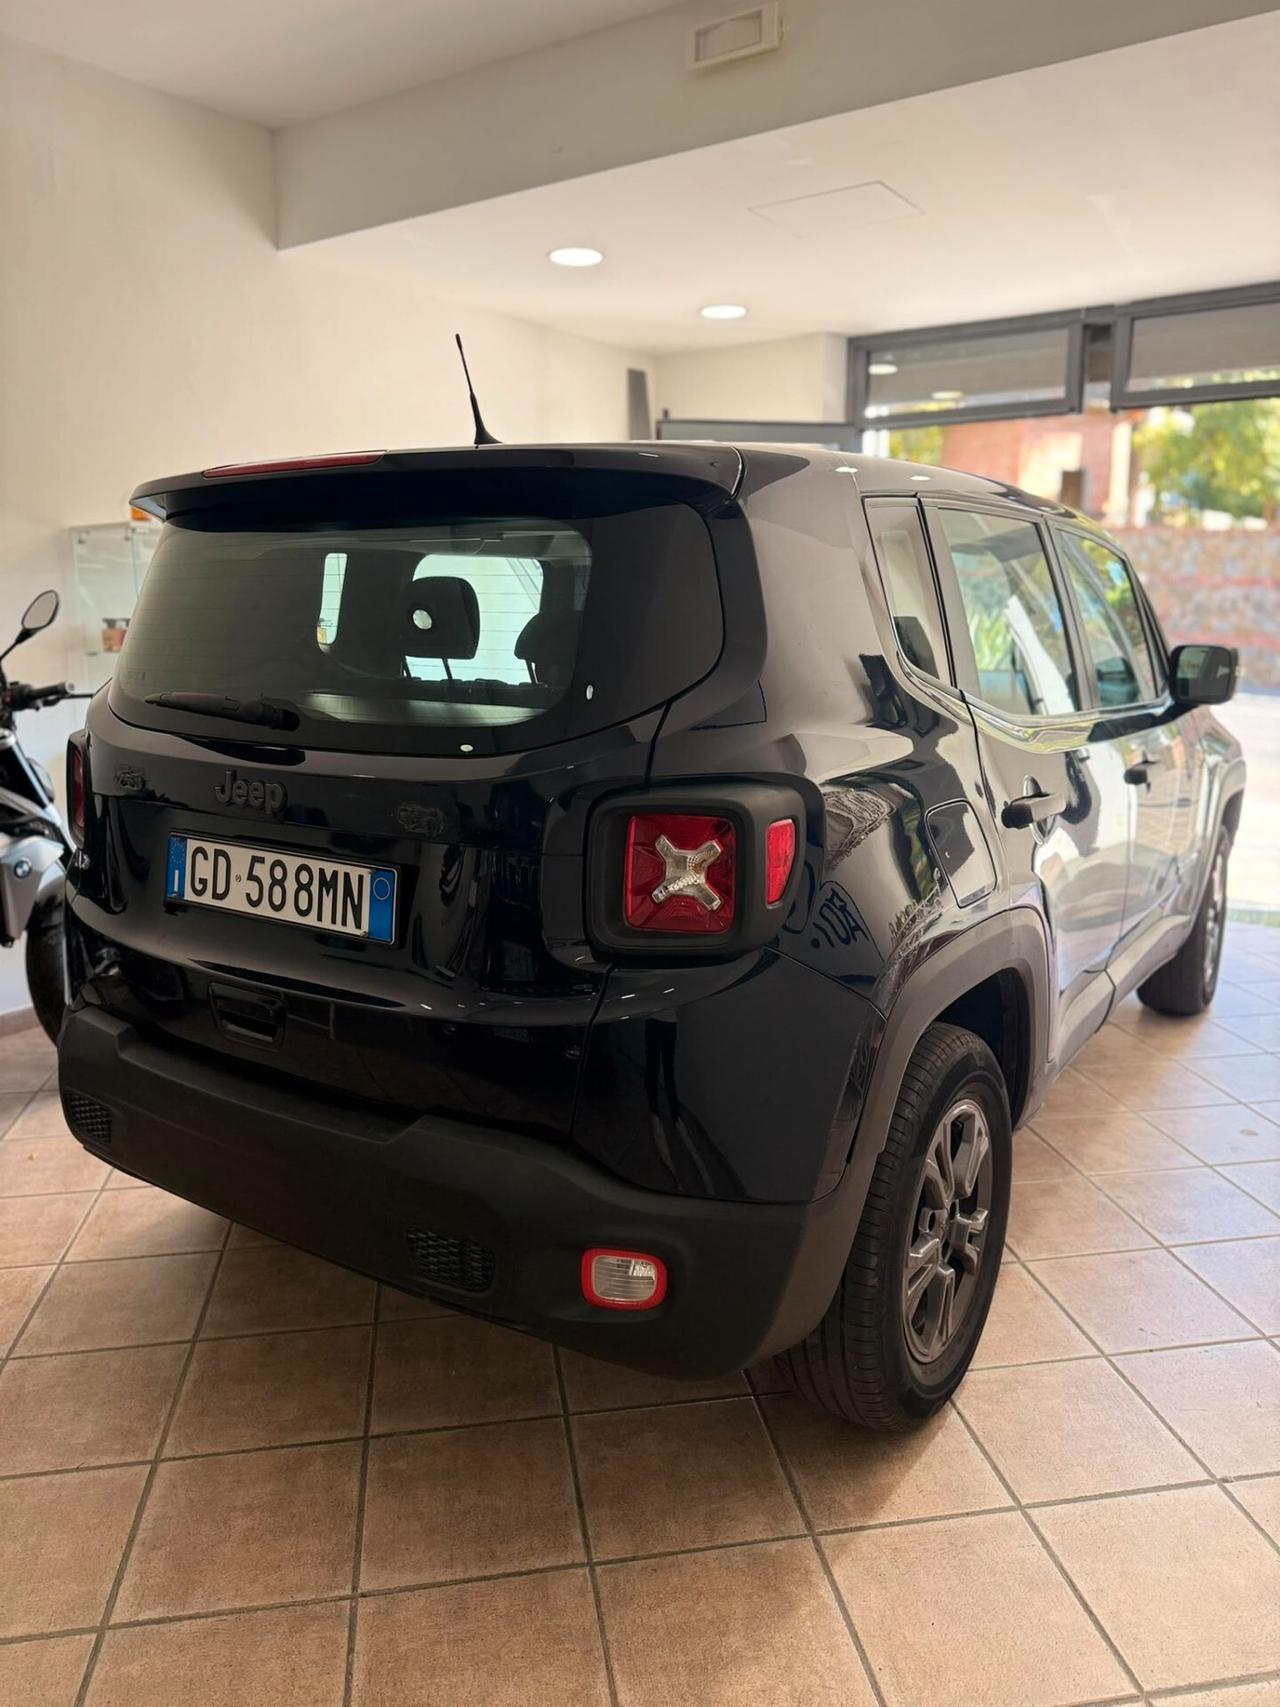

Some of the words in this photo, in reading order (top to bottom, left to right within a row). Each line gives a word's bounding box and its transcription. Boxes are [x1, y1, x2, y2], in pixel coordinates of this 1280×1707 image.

[214, 769, 287, 815] Jeep
[190, 846, 231, 901] GD
[245, 856, 364, 930] 588MN
